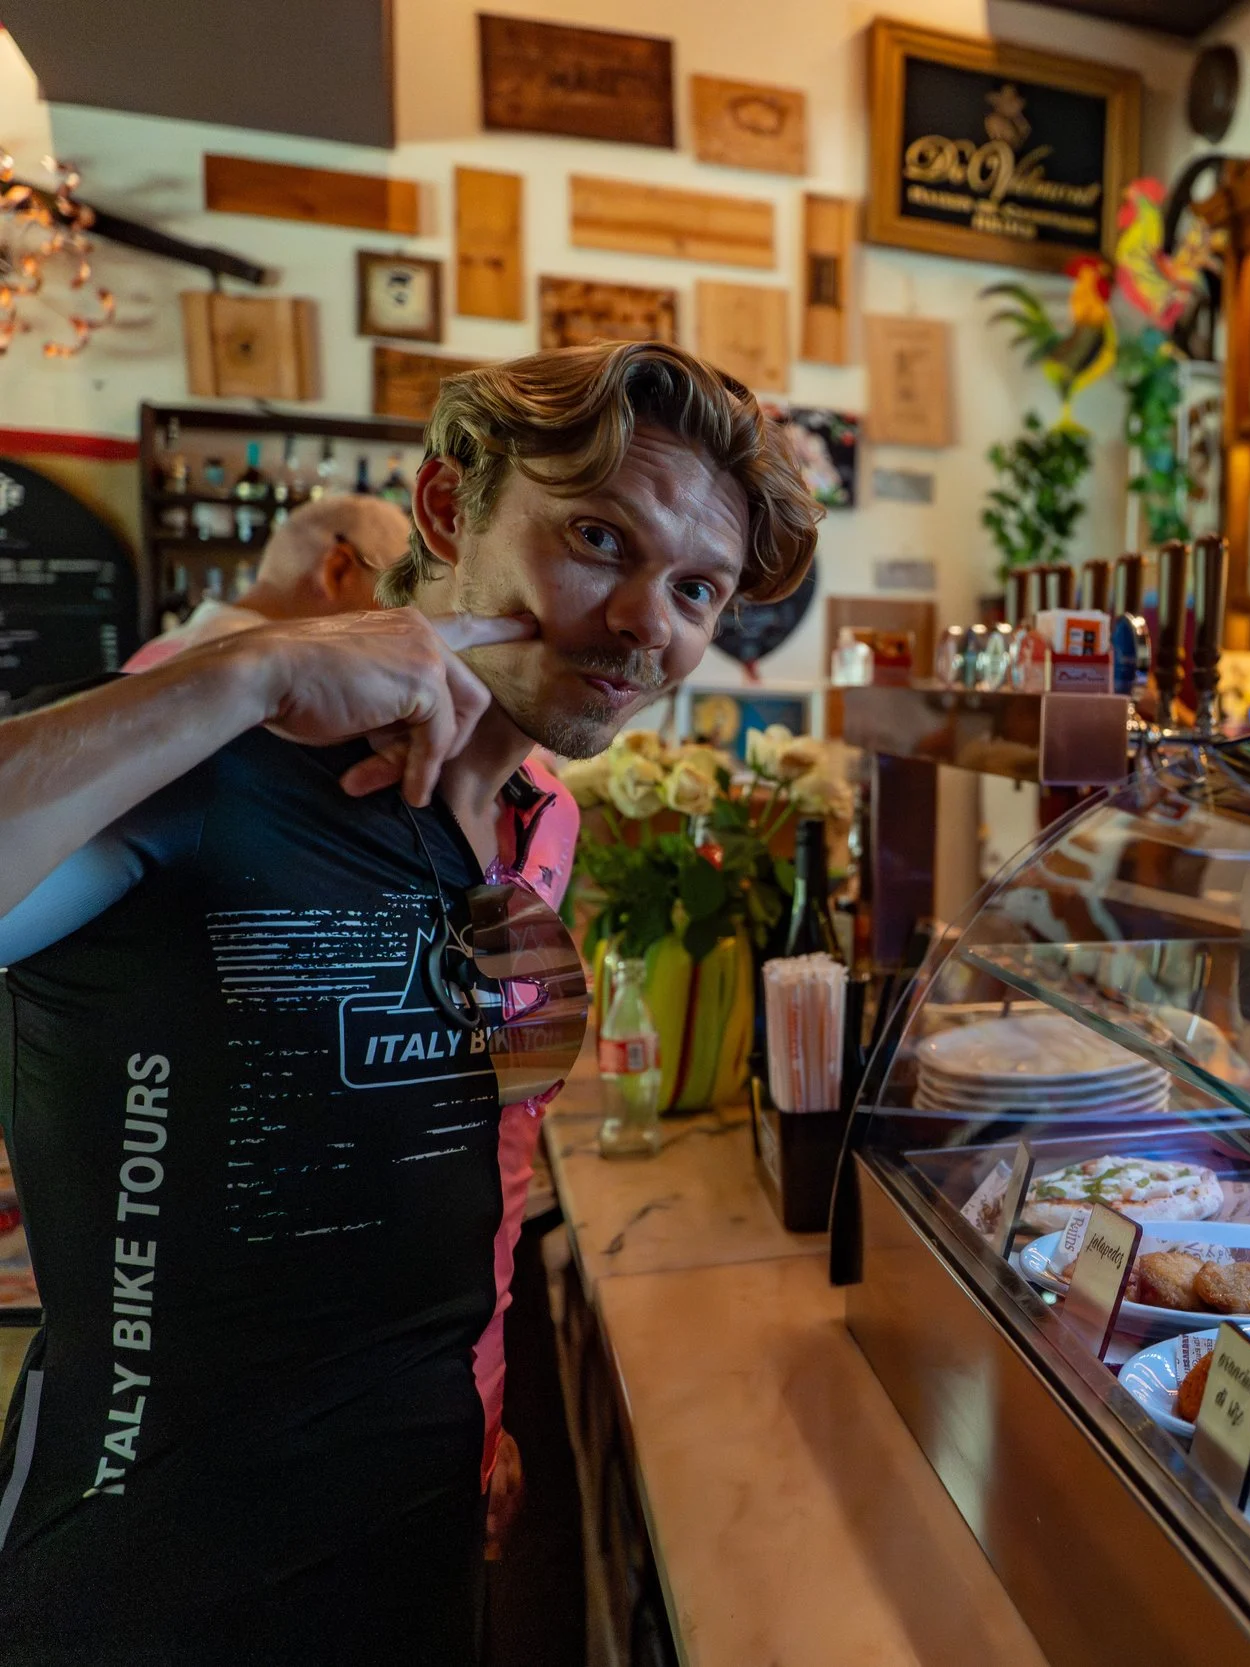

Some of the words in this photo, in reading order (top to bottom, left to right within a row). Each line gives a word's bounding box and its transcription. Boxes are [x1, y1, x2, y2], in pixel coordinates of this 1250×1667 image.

[364, 1028, 463, 1065] ITALY
[117, 1052, 170, 1222] TOURS
[113, 1237, 157, 1350] BIKE
[83, 1361, 151, 1498] ITALY
